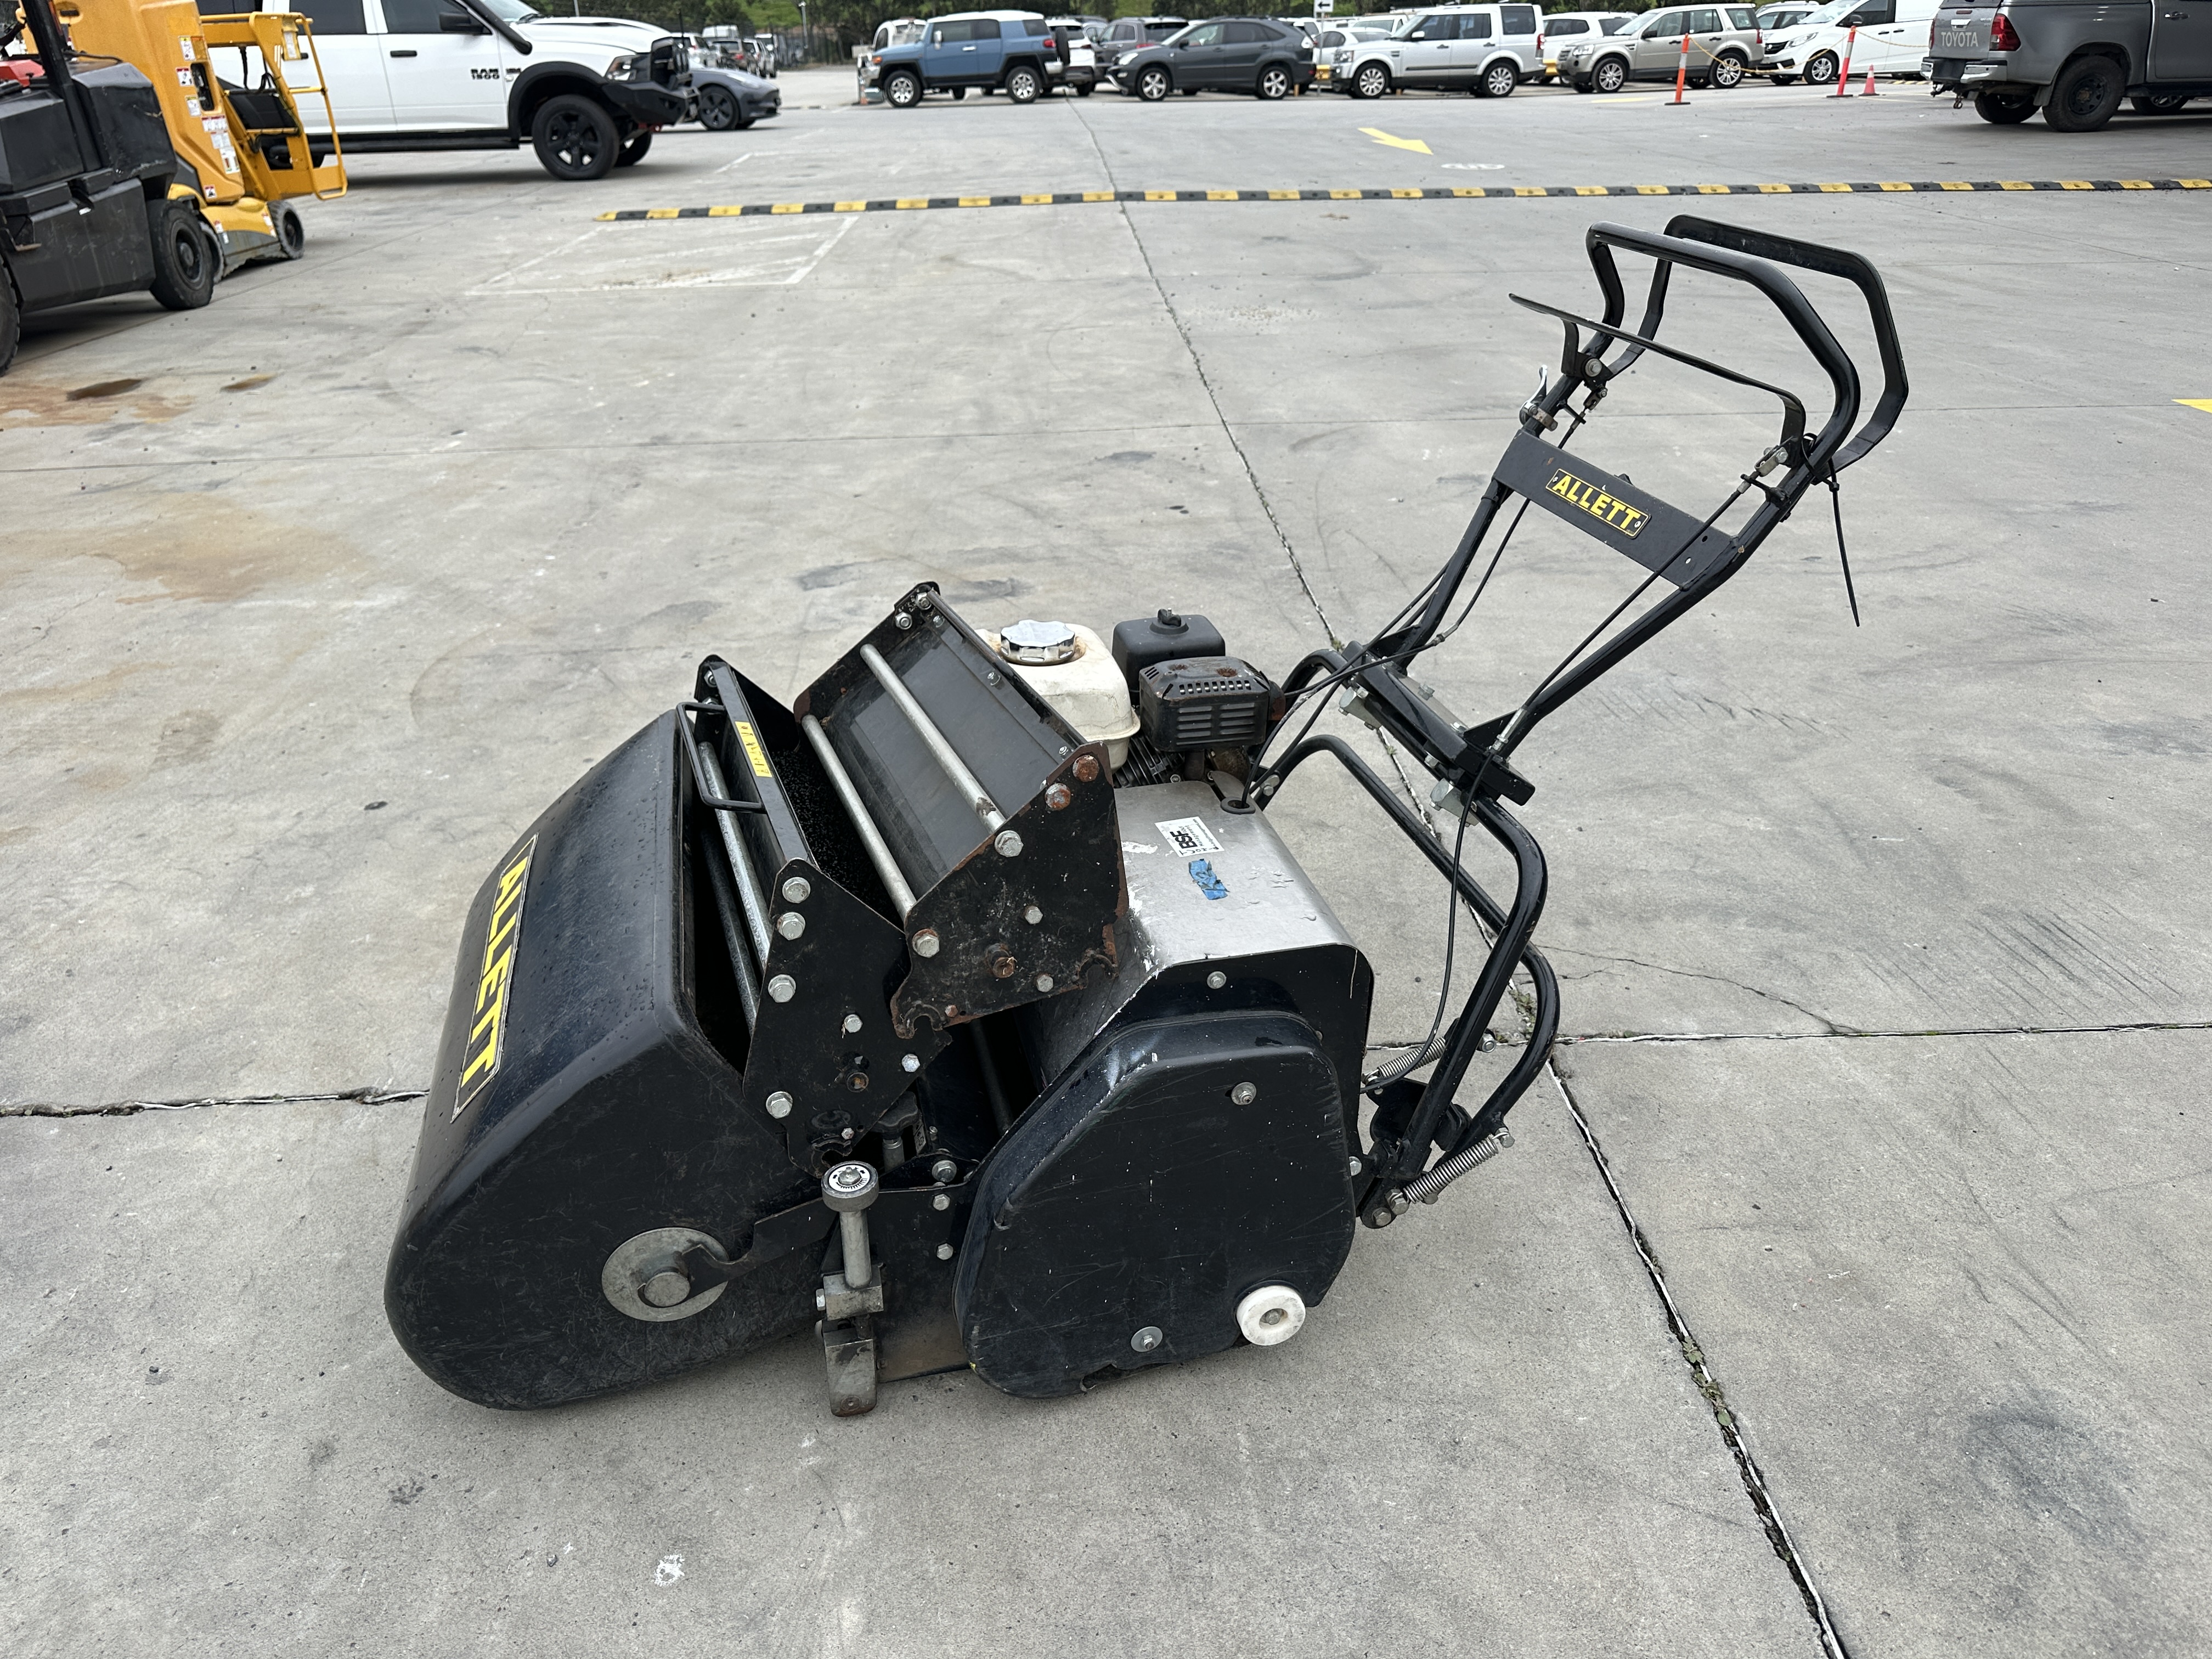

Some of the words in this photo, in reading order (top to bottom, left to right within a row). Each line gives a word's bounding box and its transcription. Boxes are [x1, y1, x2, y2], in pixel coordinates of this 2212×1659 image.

[1941, 31, 1978, 47] TOYOTA
[1553, 475, 1642, 530] ALLETT
[1170, 830, 1198, 849] BSF
[461, 856, 529, 1088] ALLETT
